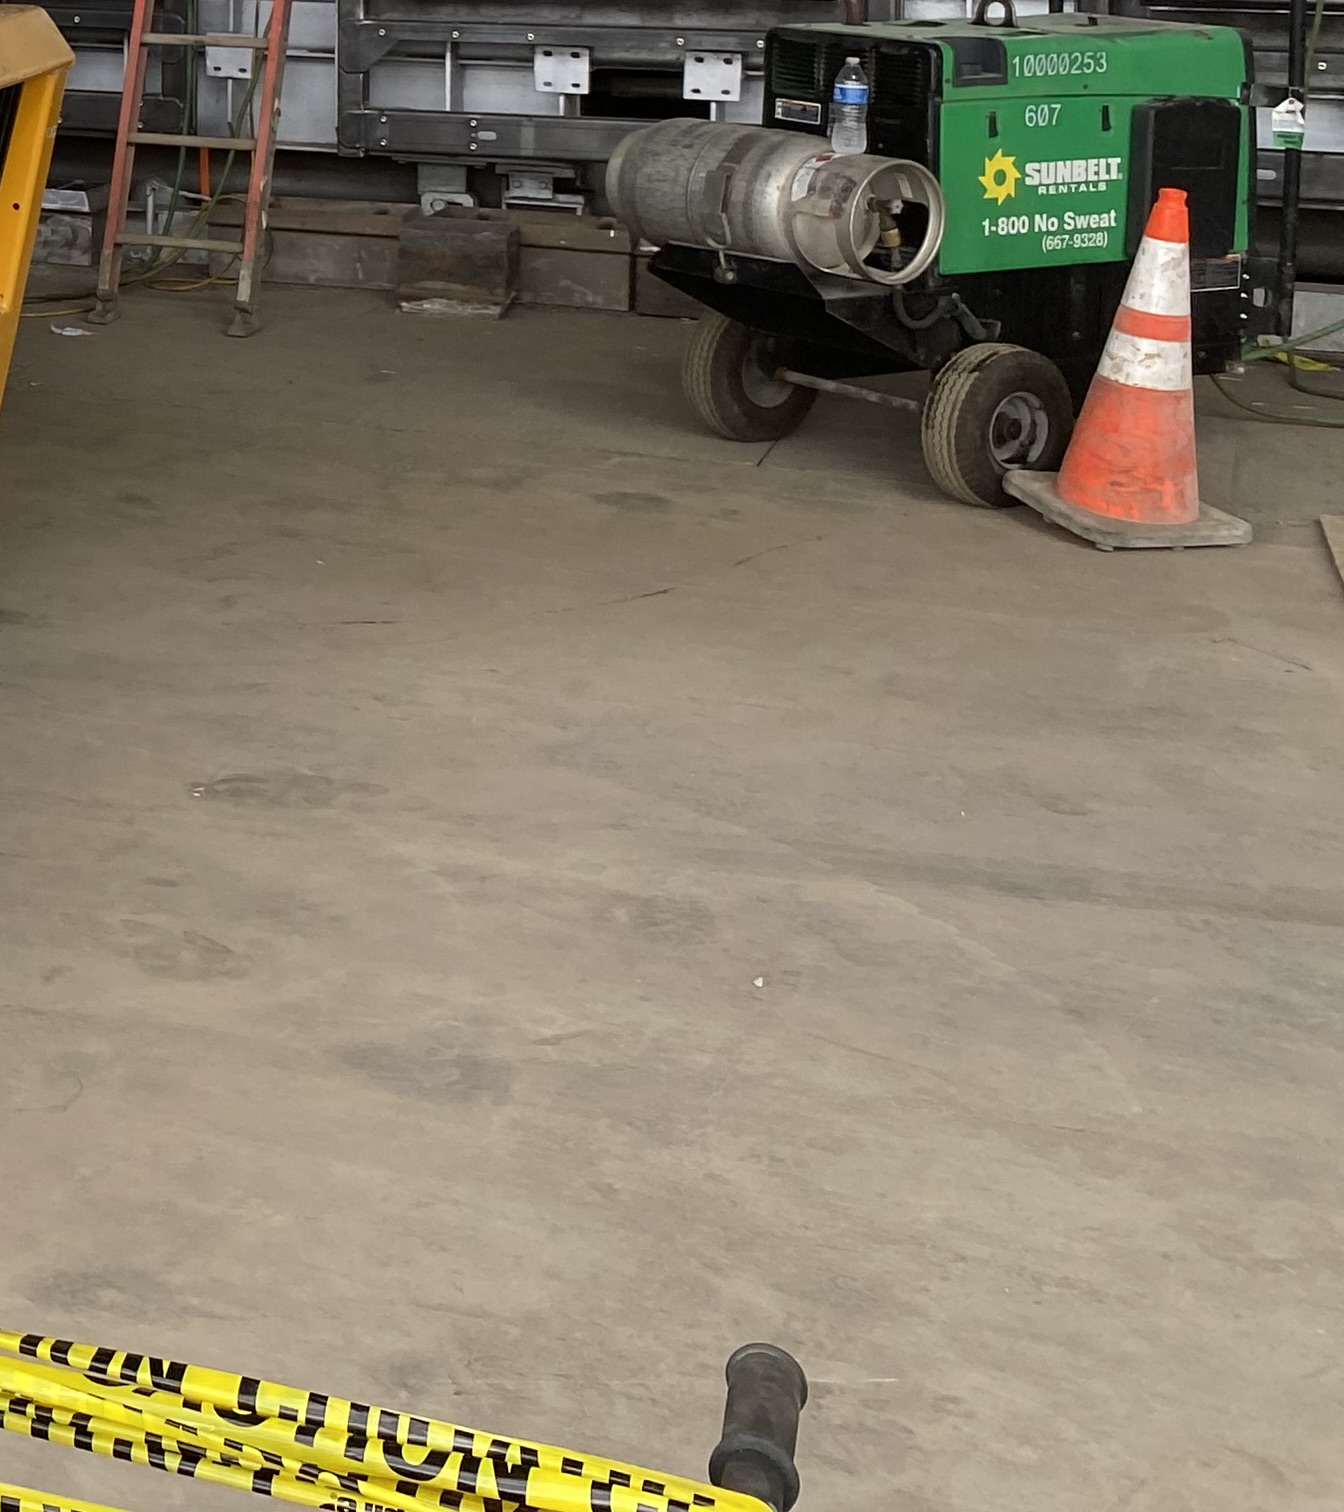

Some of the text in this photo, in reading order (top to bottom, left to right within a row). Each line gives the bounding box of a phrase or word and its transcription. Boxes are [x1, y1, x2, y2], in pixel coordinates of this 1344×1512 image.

[1011, 51, 1108, 77] 10000253
[1025, 104, 1062, 128] 607
[1024, 157, 1122, 185] SUNBELT
[1037, 181, 1108, 196] RENTALS
[981, 209, 1117, 237] 1-800 No Sweat
[1041, 230, 1109, 254] (667-9328)
